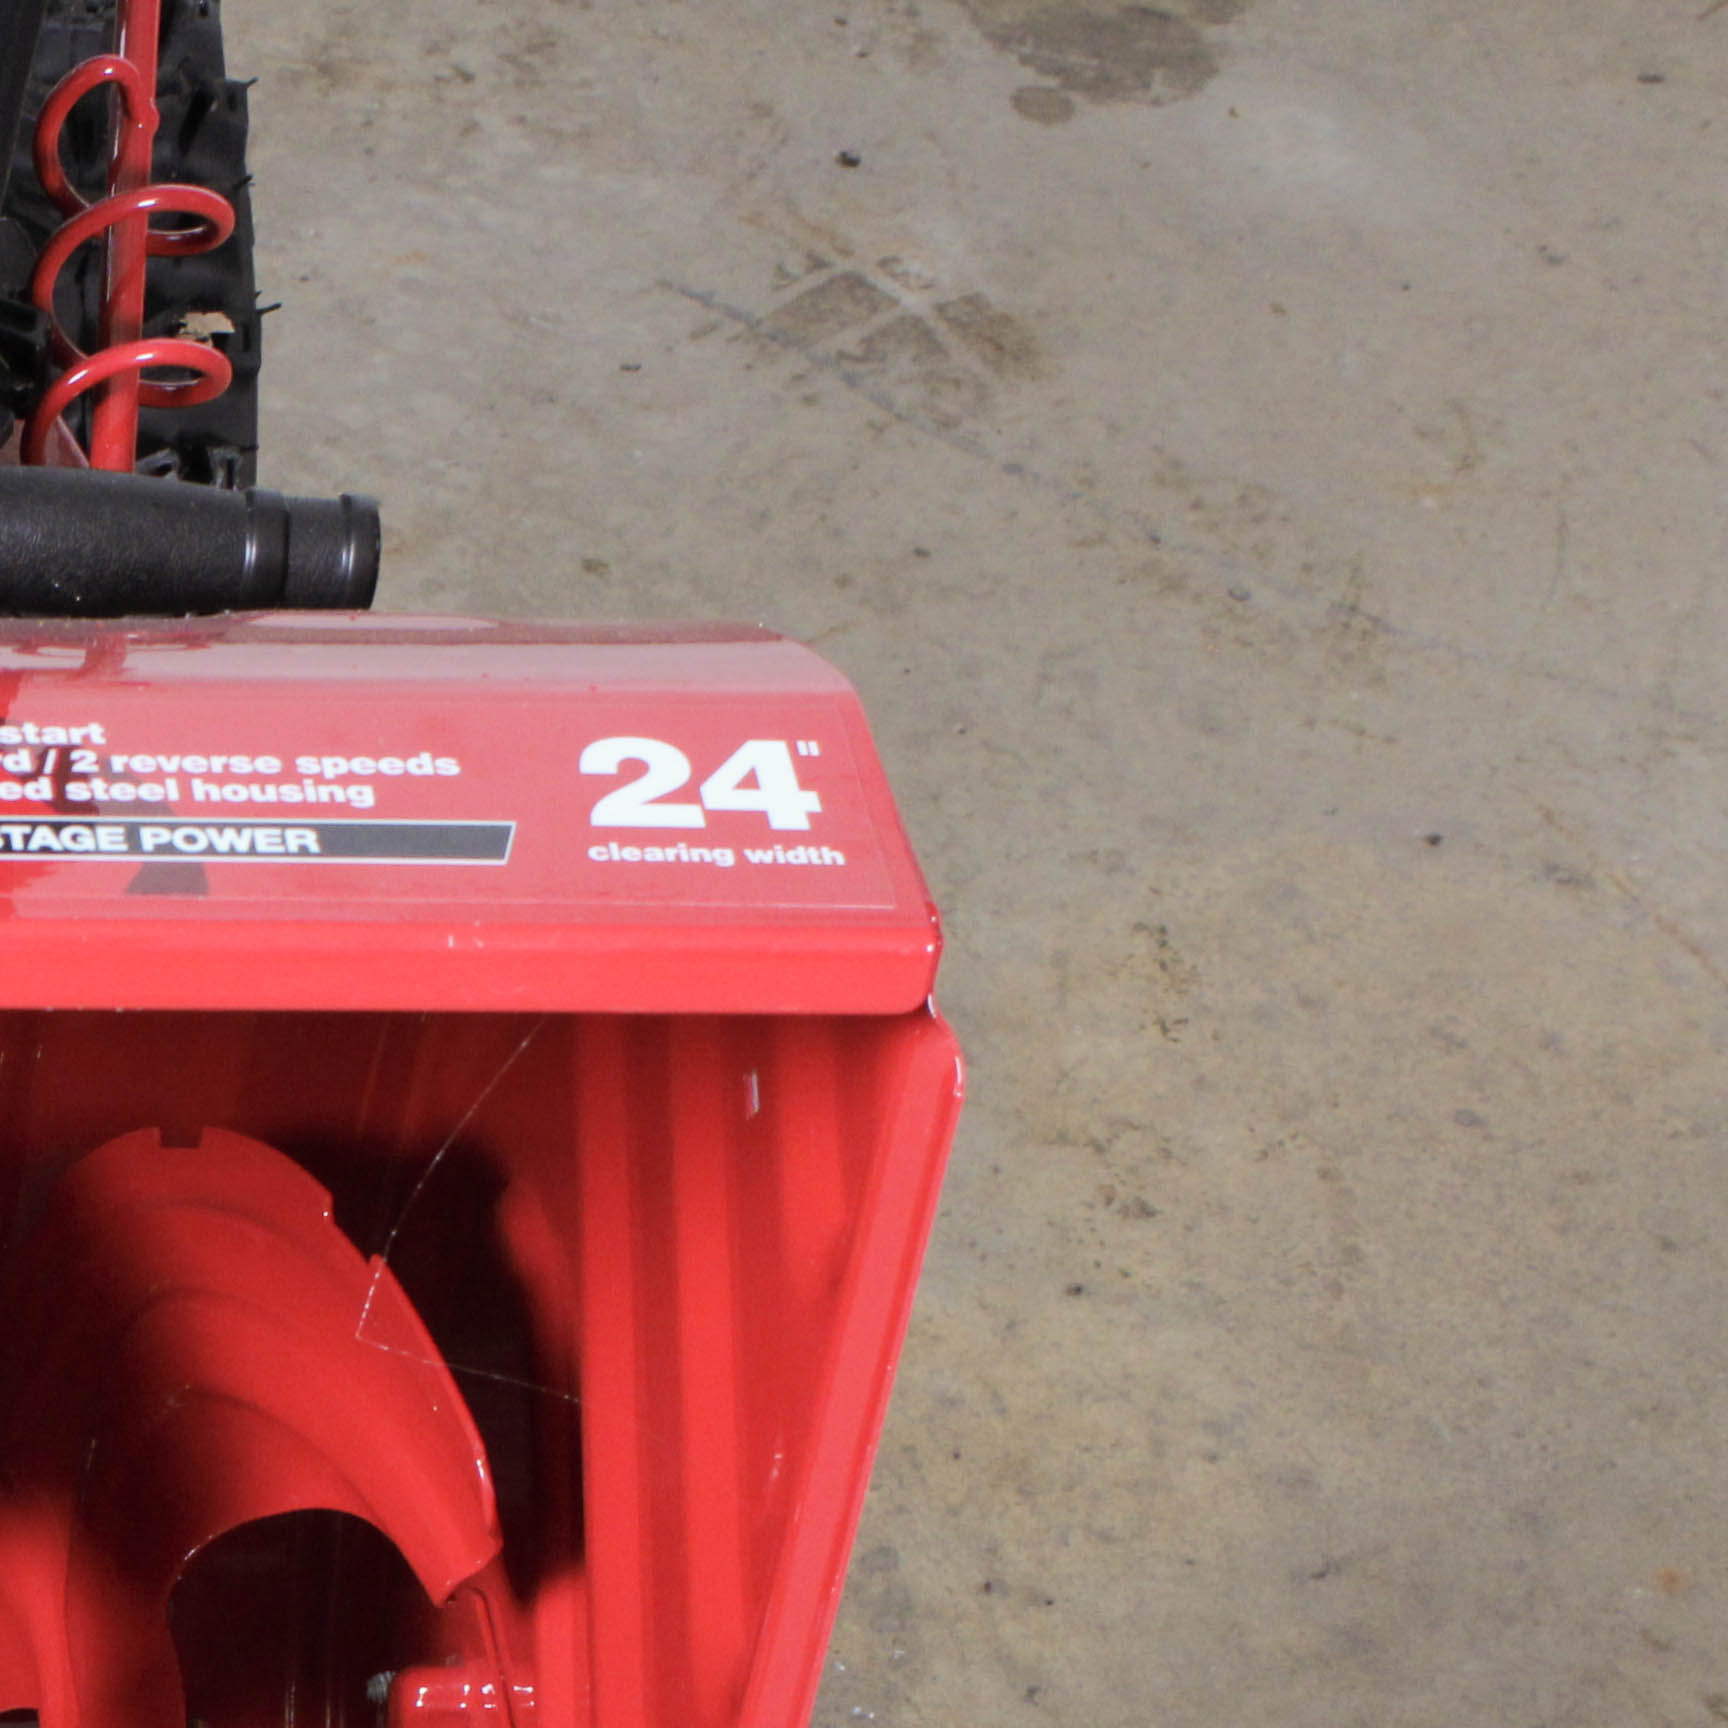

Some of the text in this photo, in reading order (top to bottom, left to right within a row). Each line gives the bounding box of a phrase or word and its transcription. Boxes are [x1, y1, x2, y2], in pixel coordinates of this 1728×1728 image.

[43, 748, 59, 775] /
[69, 750, 99, 774] 2
[109, 754, 282, 775] reverse
[295, 752, 461, 779] speeds
[64, 777, 181, 802] steel
[190, 778, 375, 808] housing
[578, 736, 823, 831] 24"
[139, 826, 321, 854] POWER
[587, 842, 846, 867] clearing width
